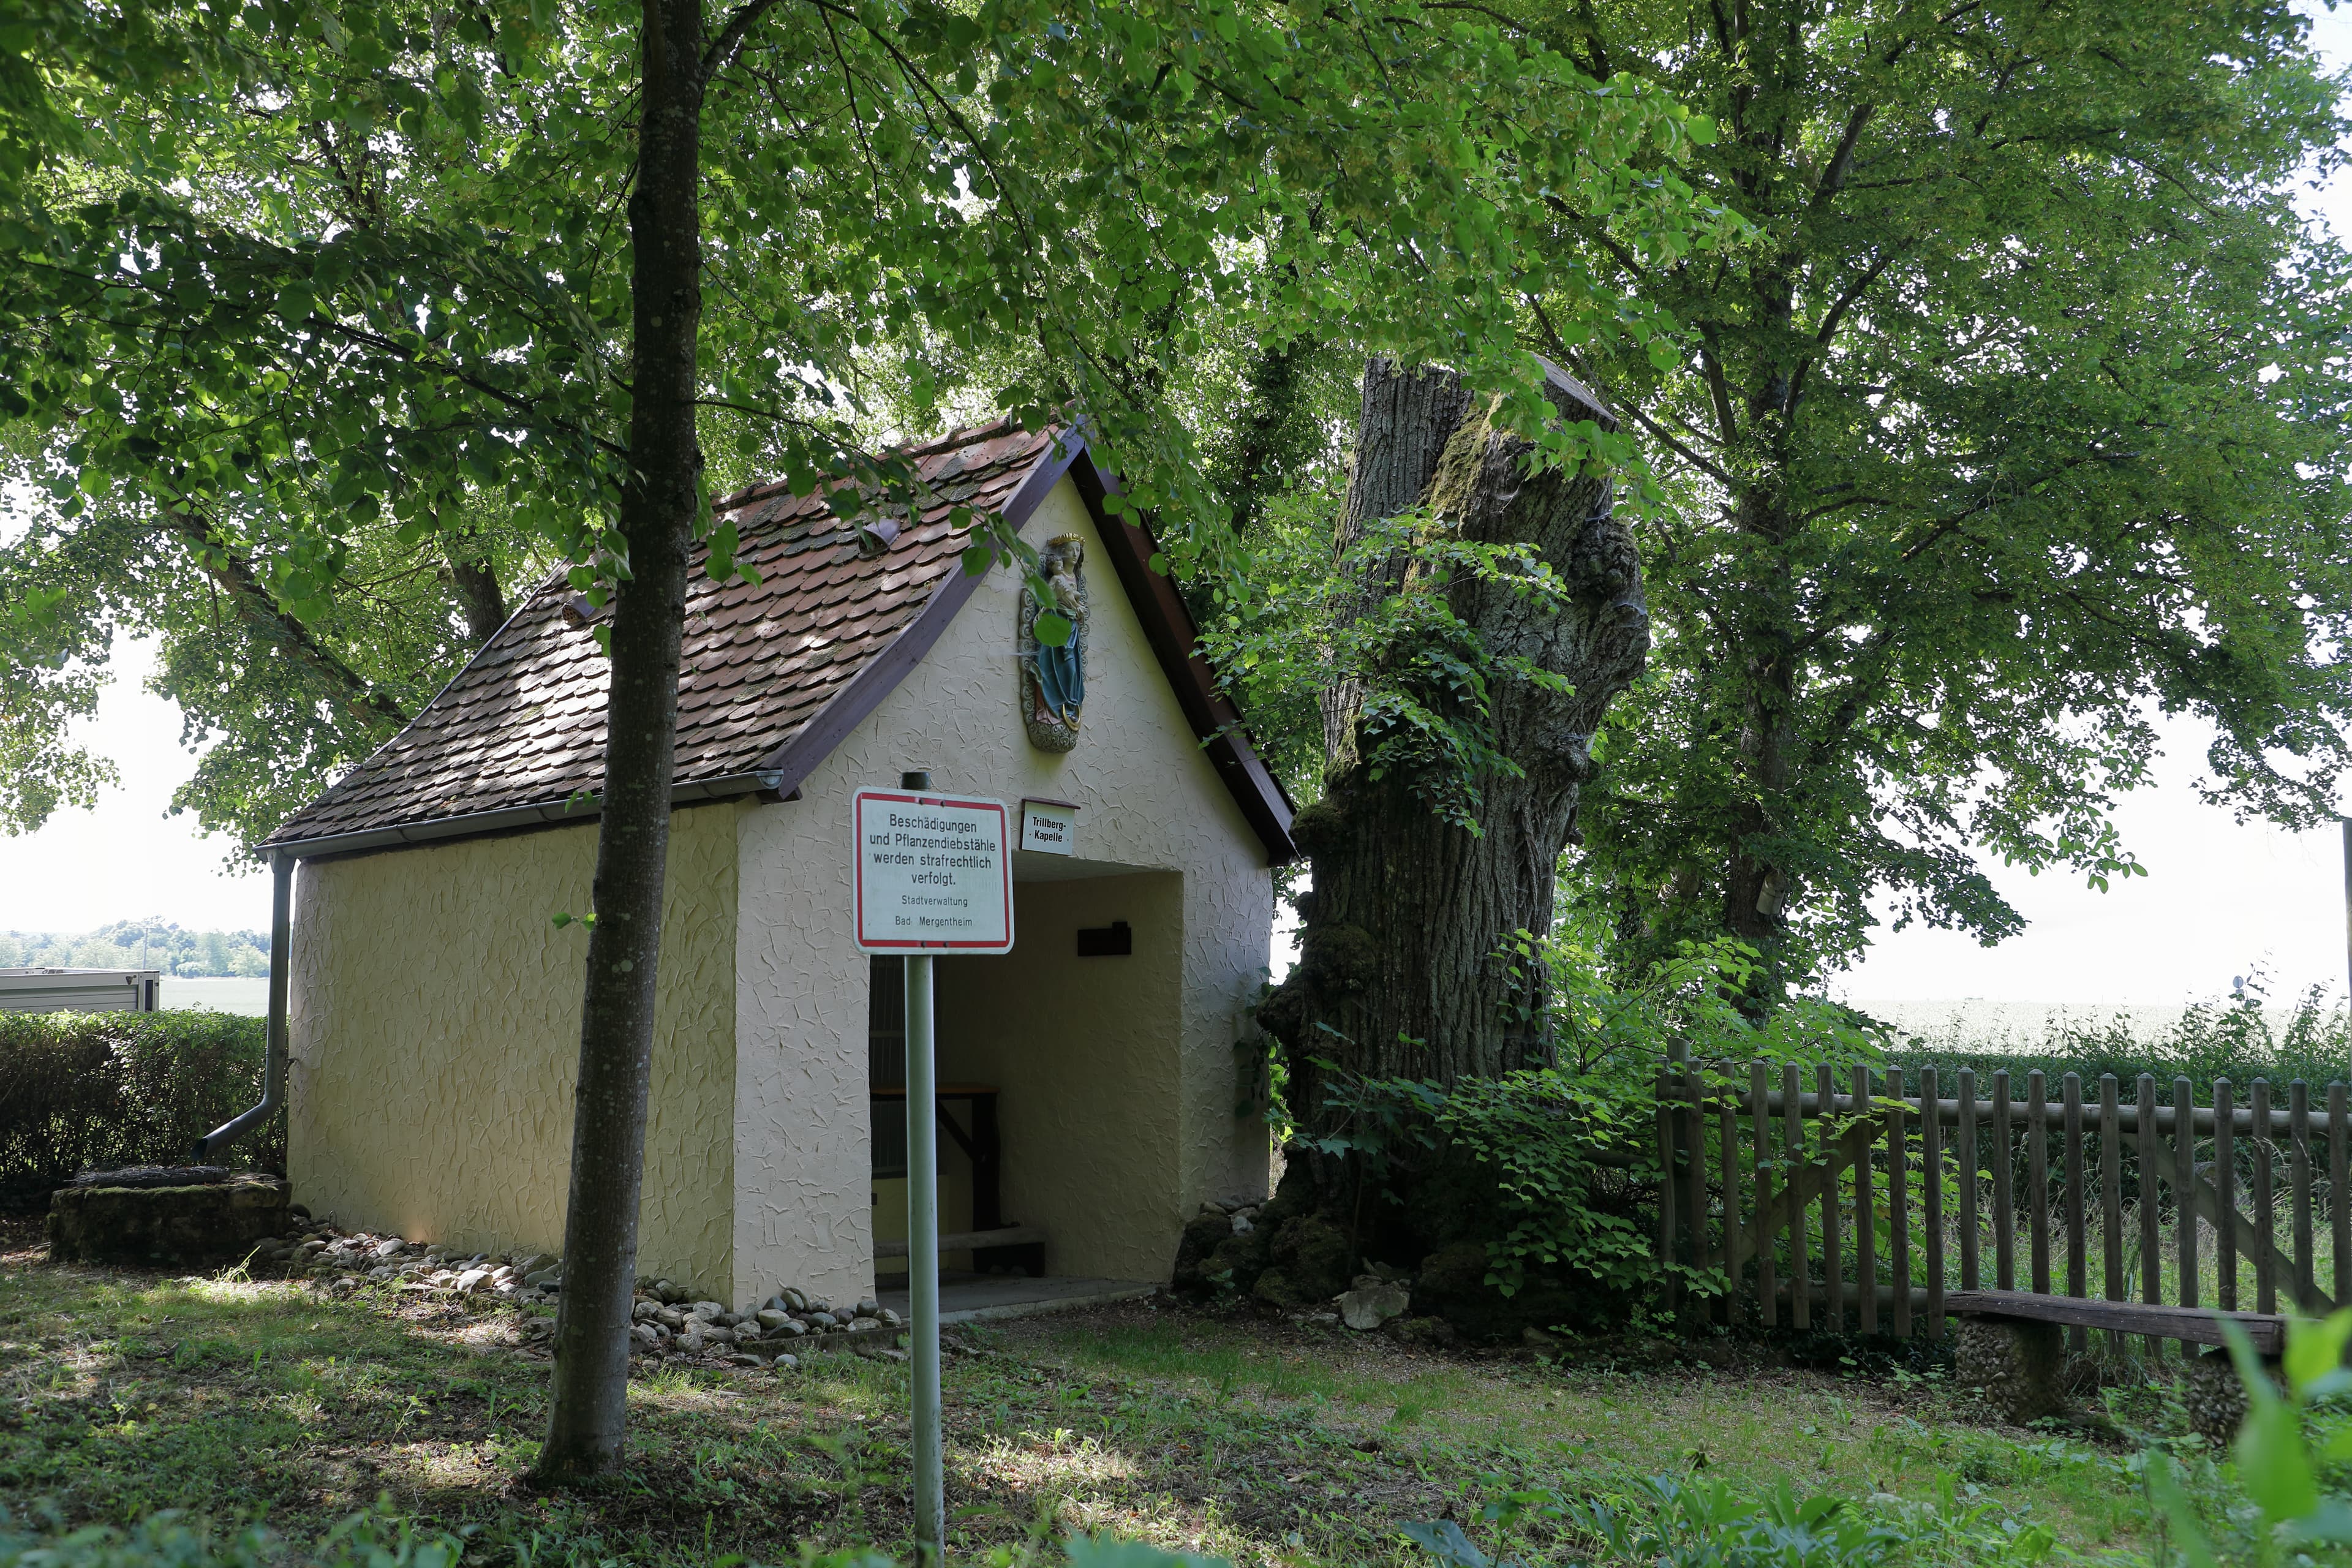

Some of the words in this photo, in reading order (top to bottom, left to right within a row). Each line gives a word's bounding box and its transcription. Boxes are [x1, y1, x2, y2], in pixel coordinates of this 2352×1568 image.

[890, 814, 976, 833] Beschädigungen
[1033, 816, 1066, 831] Trillberg-
[870, 833, 889, 845] und
[895, 834, 995, 851] Pflanzendiebstähle
[1035, 830, 1062, 842] Kapelle
[874, 852, 914, 865] werden
[921, 854, 991, 869] strafrechtlich
[911, 872, 956, 886] verfolgt.
[902, 895, 968, 907] Stadtverwaltung
[895, 916, 911, 925] Bad
[919, 917, 973, 927] Mergentheim
